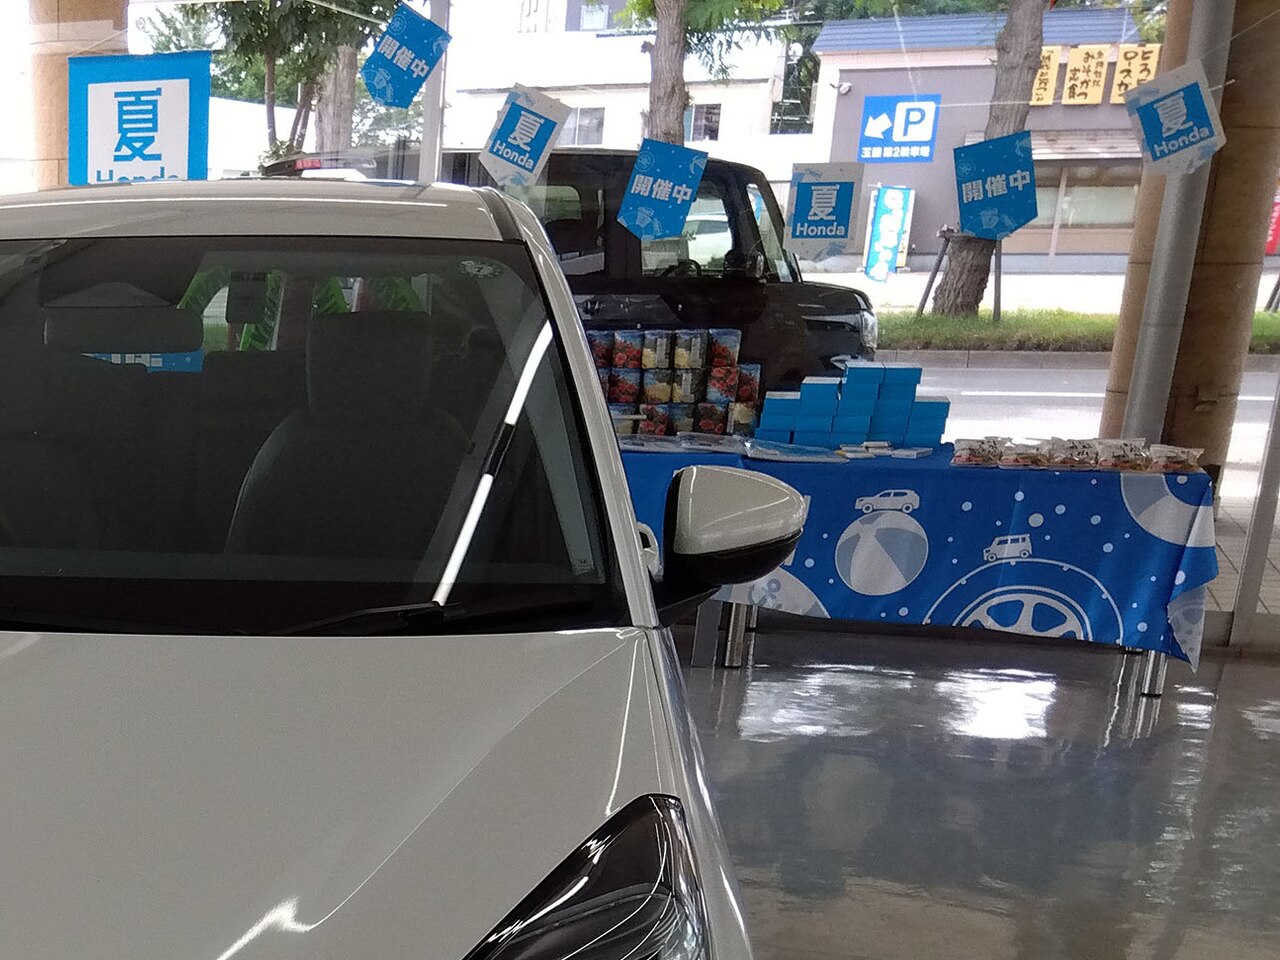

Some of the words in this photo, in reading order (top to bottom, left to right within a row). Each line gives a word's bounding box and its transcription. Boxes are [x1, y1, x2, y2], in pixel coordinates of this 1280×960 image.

[377, 34, 429, 78] 開催中
[1116, 50, 1138, 97] ロースか
[113, 87, 162, 162] 夏
[507, 110, 545, 152] 夏
[903, 107, 926, 136] P
[1153, 91, 1194, 137] 夏
[493, 140, 535, 170] Honda
[1153, 126, 1210, 158] Honda
[631, 173, 693, 205] 開催中
[808, 184, 840, 221] 夏
[962, 169, 1031, 203] 開催中
[796, 222, 845, 236] Honda
